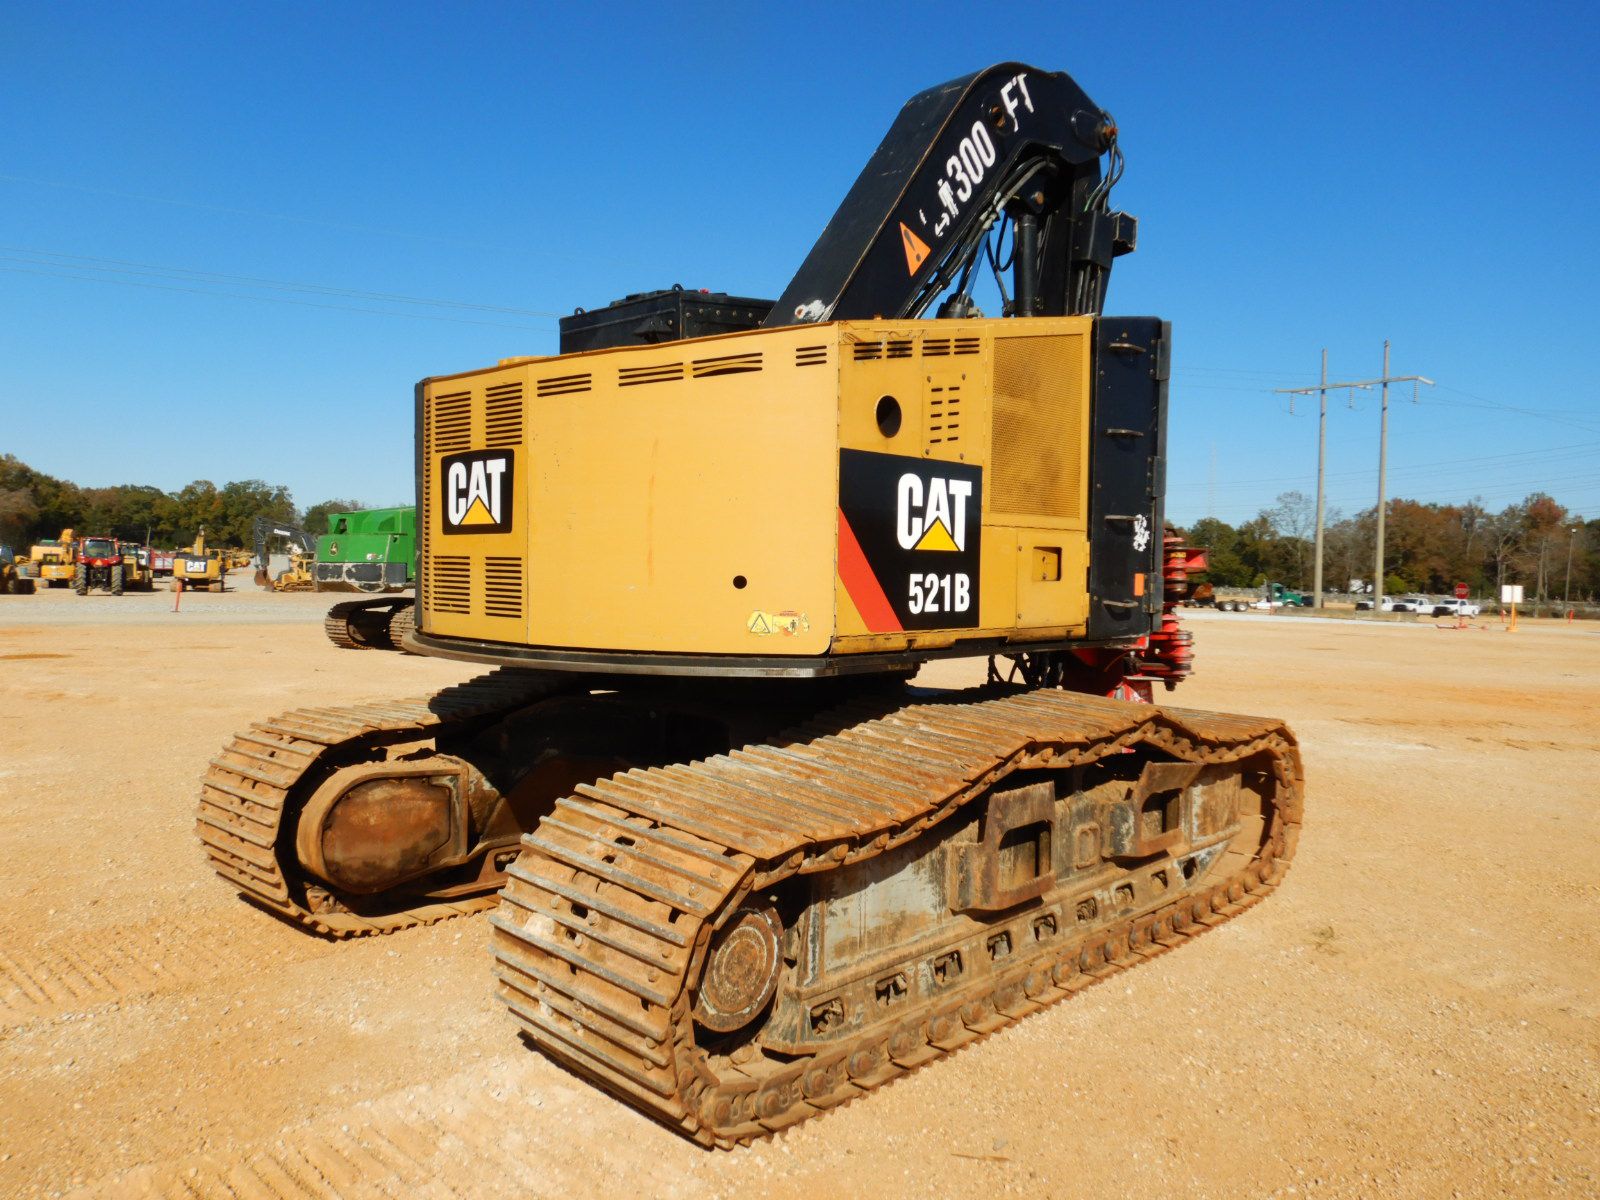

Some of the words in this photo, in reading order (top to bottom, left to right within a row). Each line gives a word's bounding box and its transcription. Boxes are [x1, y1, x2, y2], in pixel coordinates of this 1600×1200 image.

[946, 120, 996, 203] 300
[1001, 73, 1034, 132] FT
[448, 458, 506, 525] CAT
[897, 473, 972, 552] CAT
[186, 561, 206, 572] CAT
[908, 573, 970, 614] 521B
